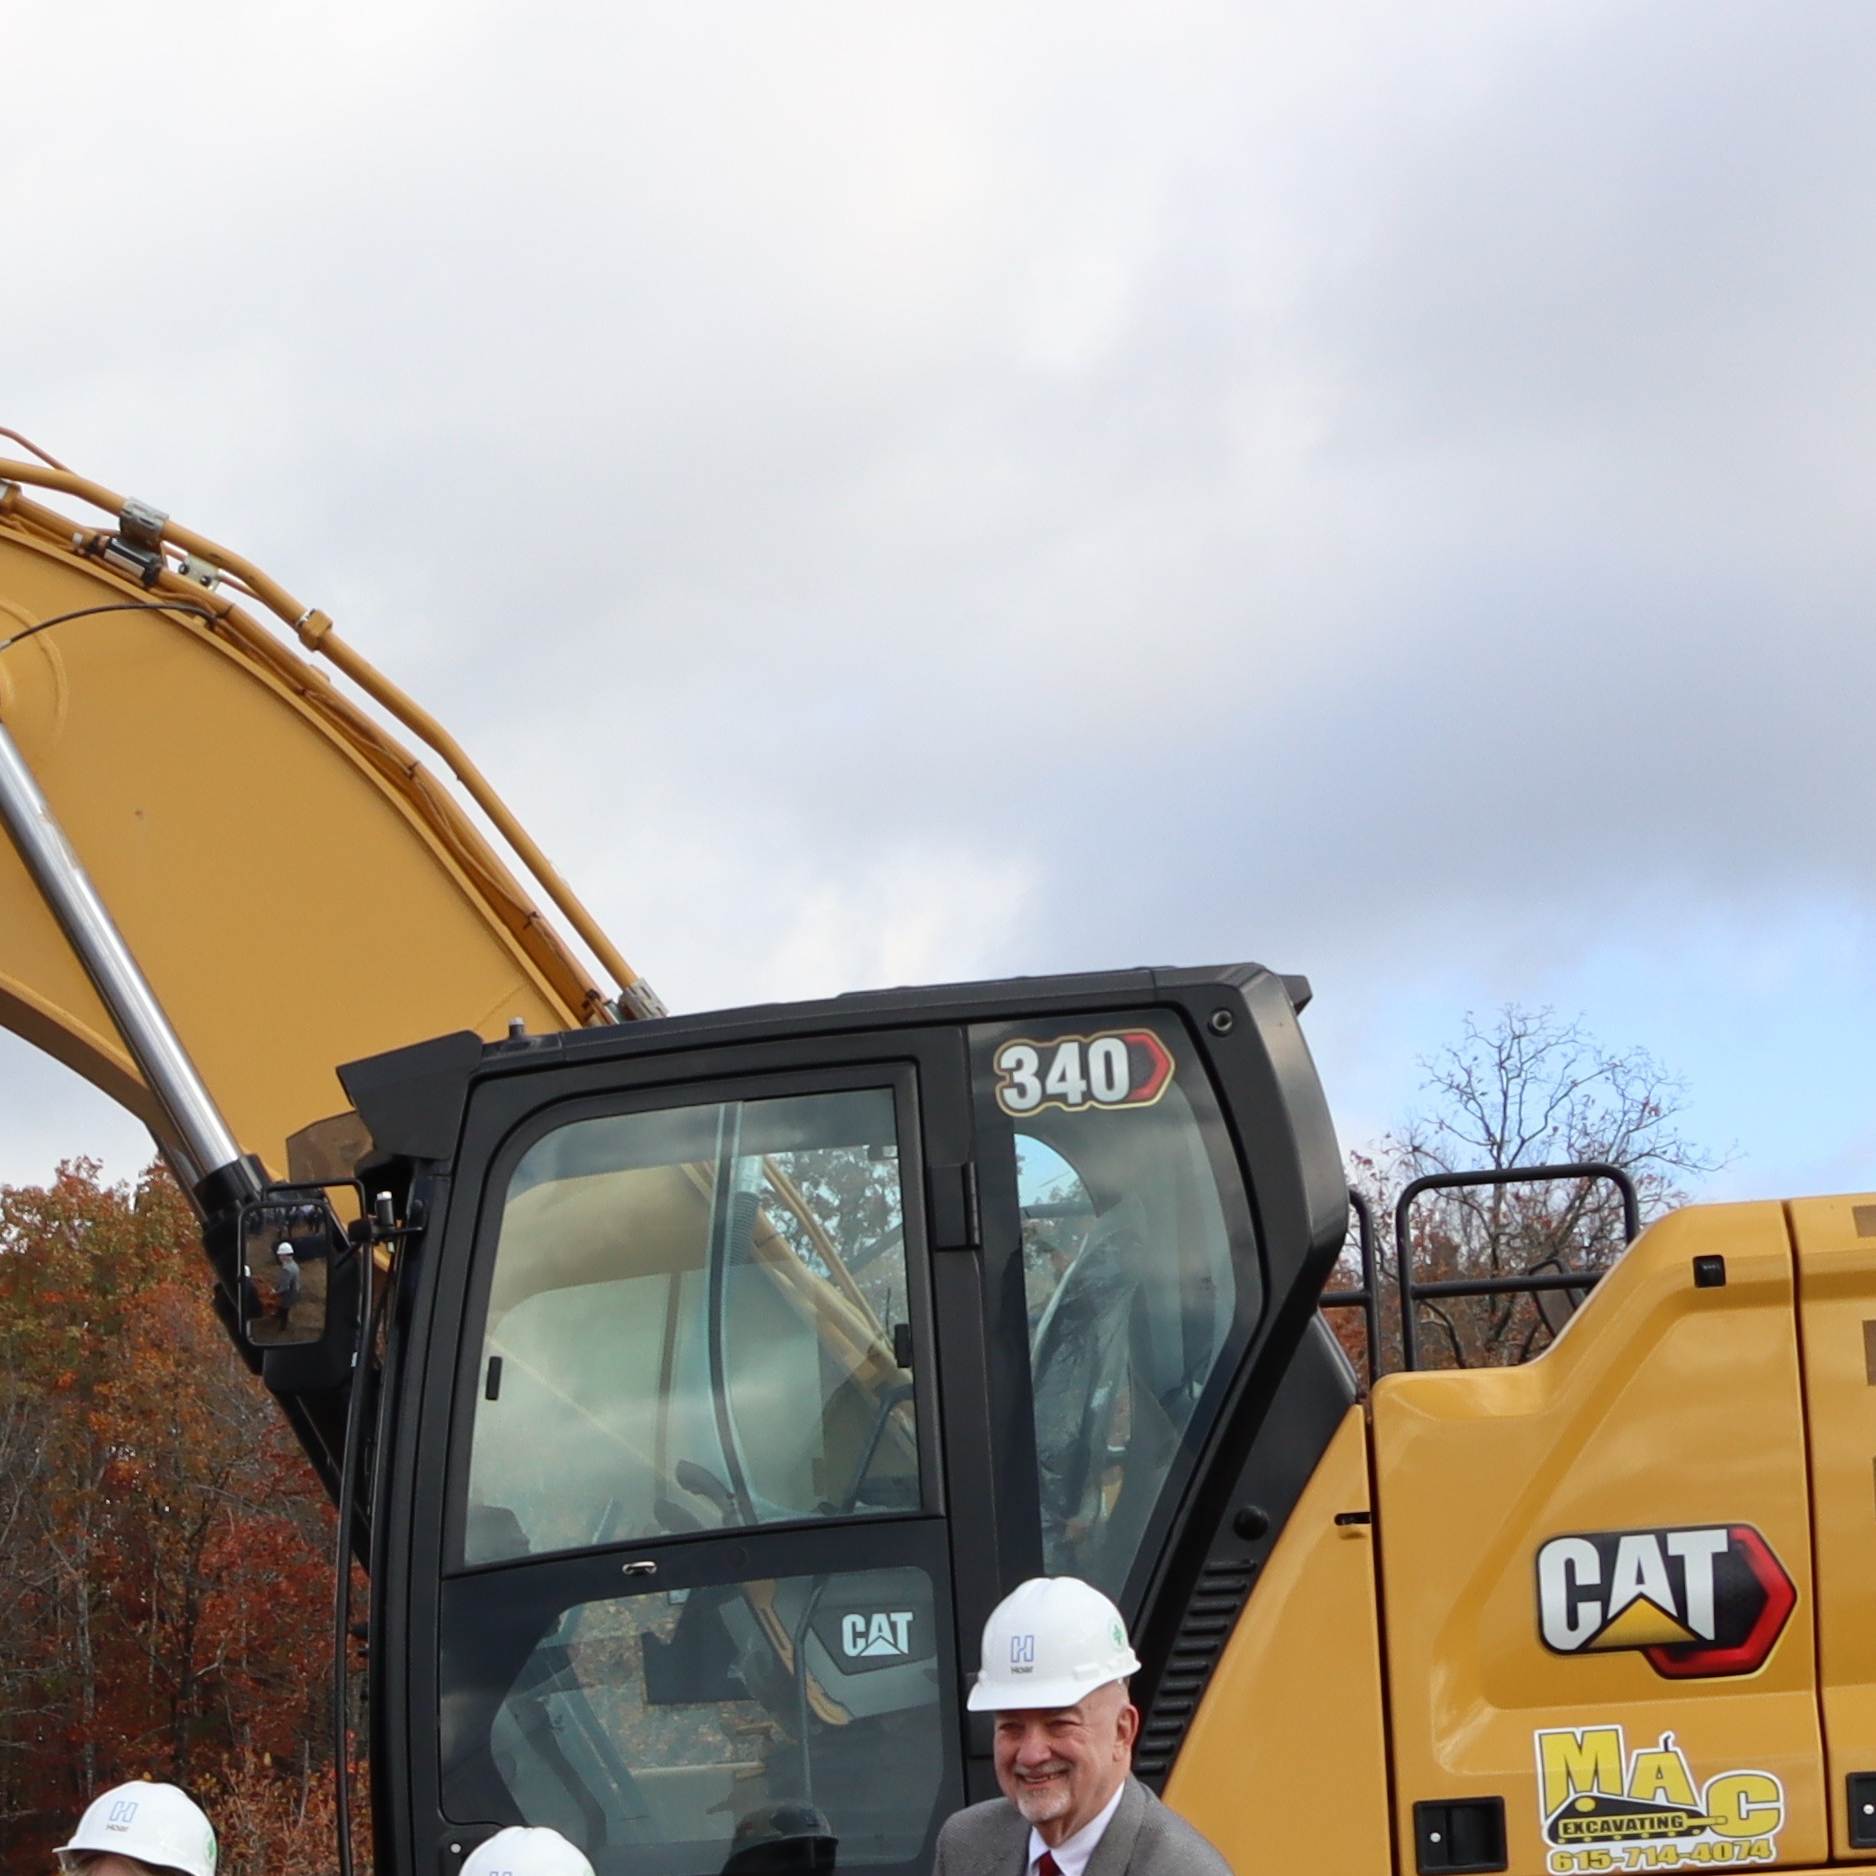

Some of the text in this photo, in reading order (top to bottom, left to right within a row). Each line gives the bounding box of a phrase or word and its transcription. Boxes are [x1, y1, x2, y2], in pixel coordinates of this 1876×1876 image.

[999, 1037, 1130, 1107] 340
[1538, 1528, 1728, 1651] CAT
[843, 1611, 913, 1657] CAT
[1539, 1729, 1781, 1838] MAC
[1563, 1815, 1683, 1835] EXCAVATING
[1550, 1839, 1771, 1872] 615-714-4074
